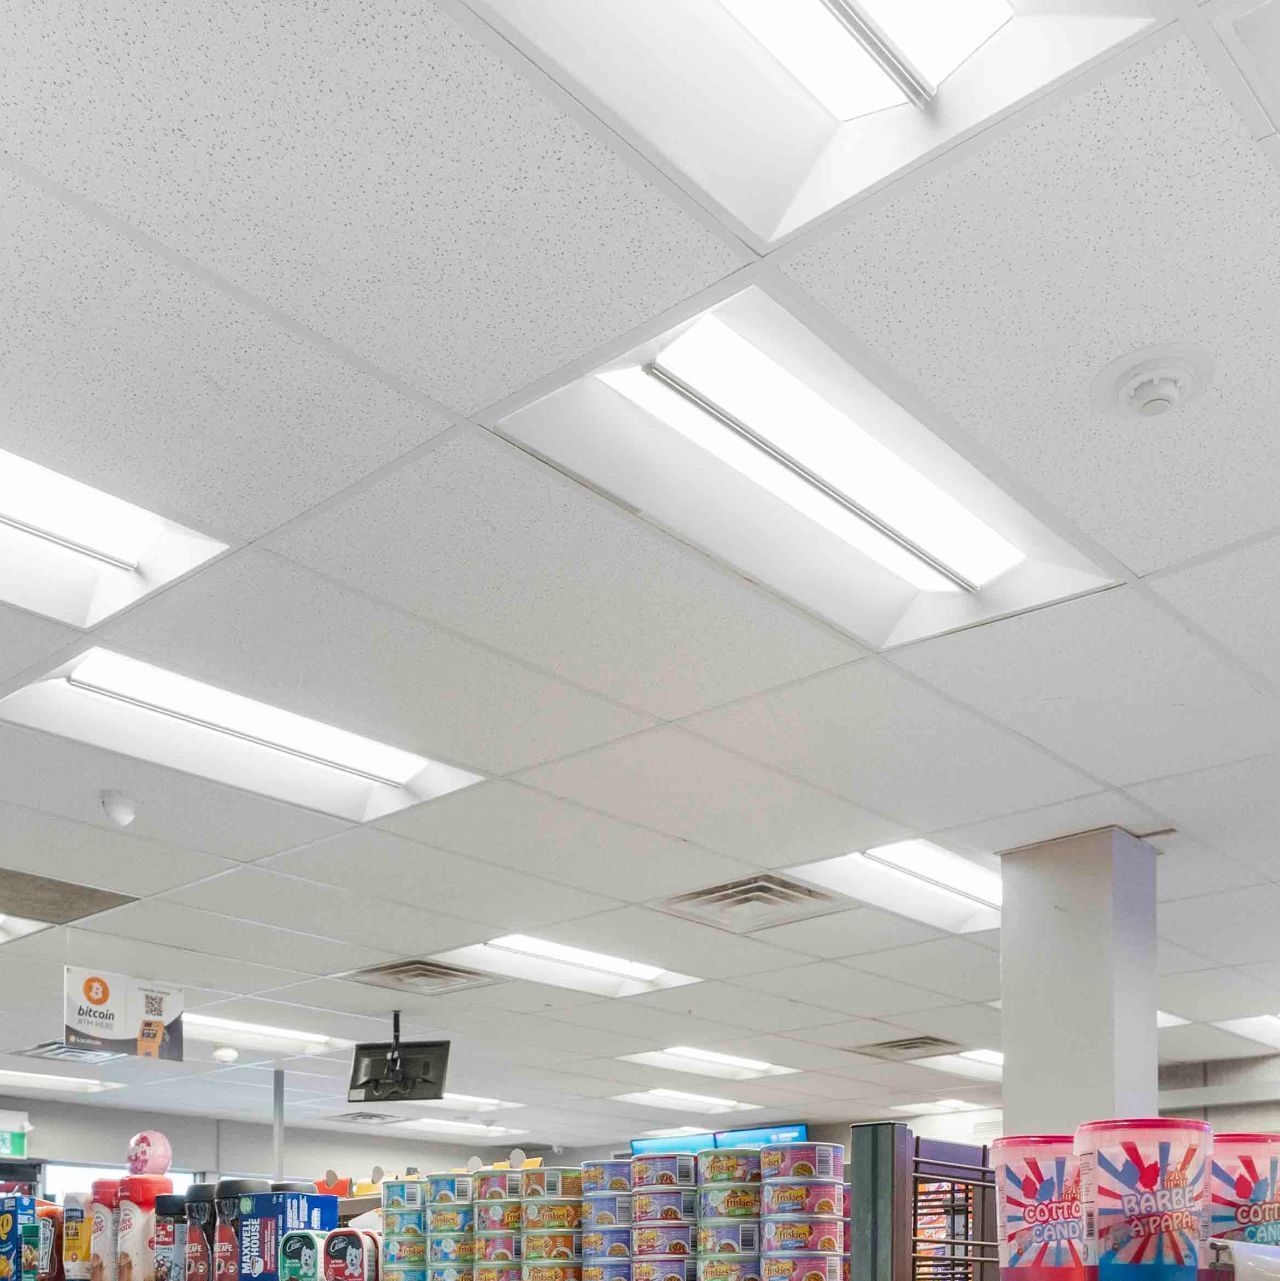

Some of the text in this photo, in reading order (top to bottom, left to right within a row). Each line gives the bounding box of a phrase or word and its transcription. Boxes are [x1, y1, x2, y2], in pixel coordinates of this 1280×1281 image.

[77, 1004, 115, 1021] bitcoin
[1023, 1201, 1082, 1223] COTTO
[1121, 1185, 1196, 1217] BARBE
[251, 1217, 261, 1258] HOUSE
[1131, 1209, 1193, 1237] À PAPA
[241, 1217, 252, 1275] MAXWELL
